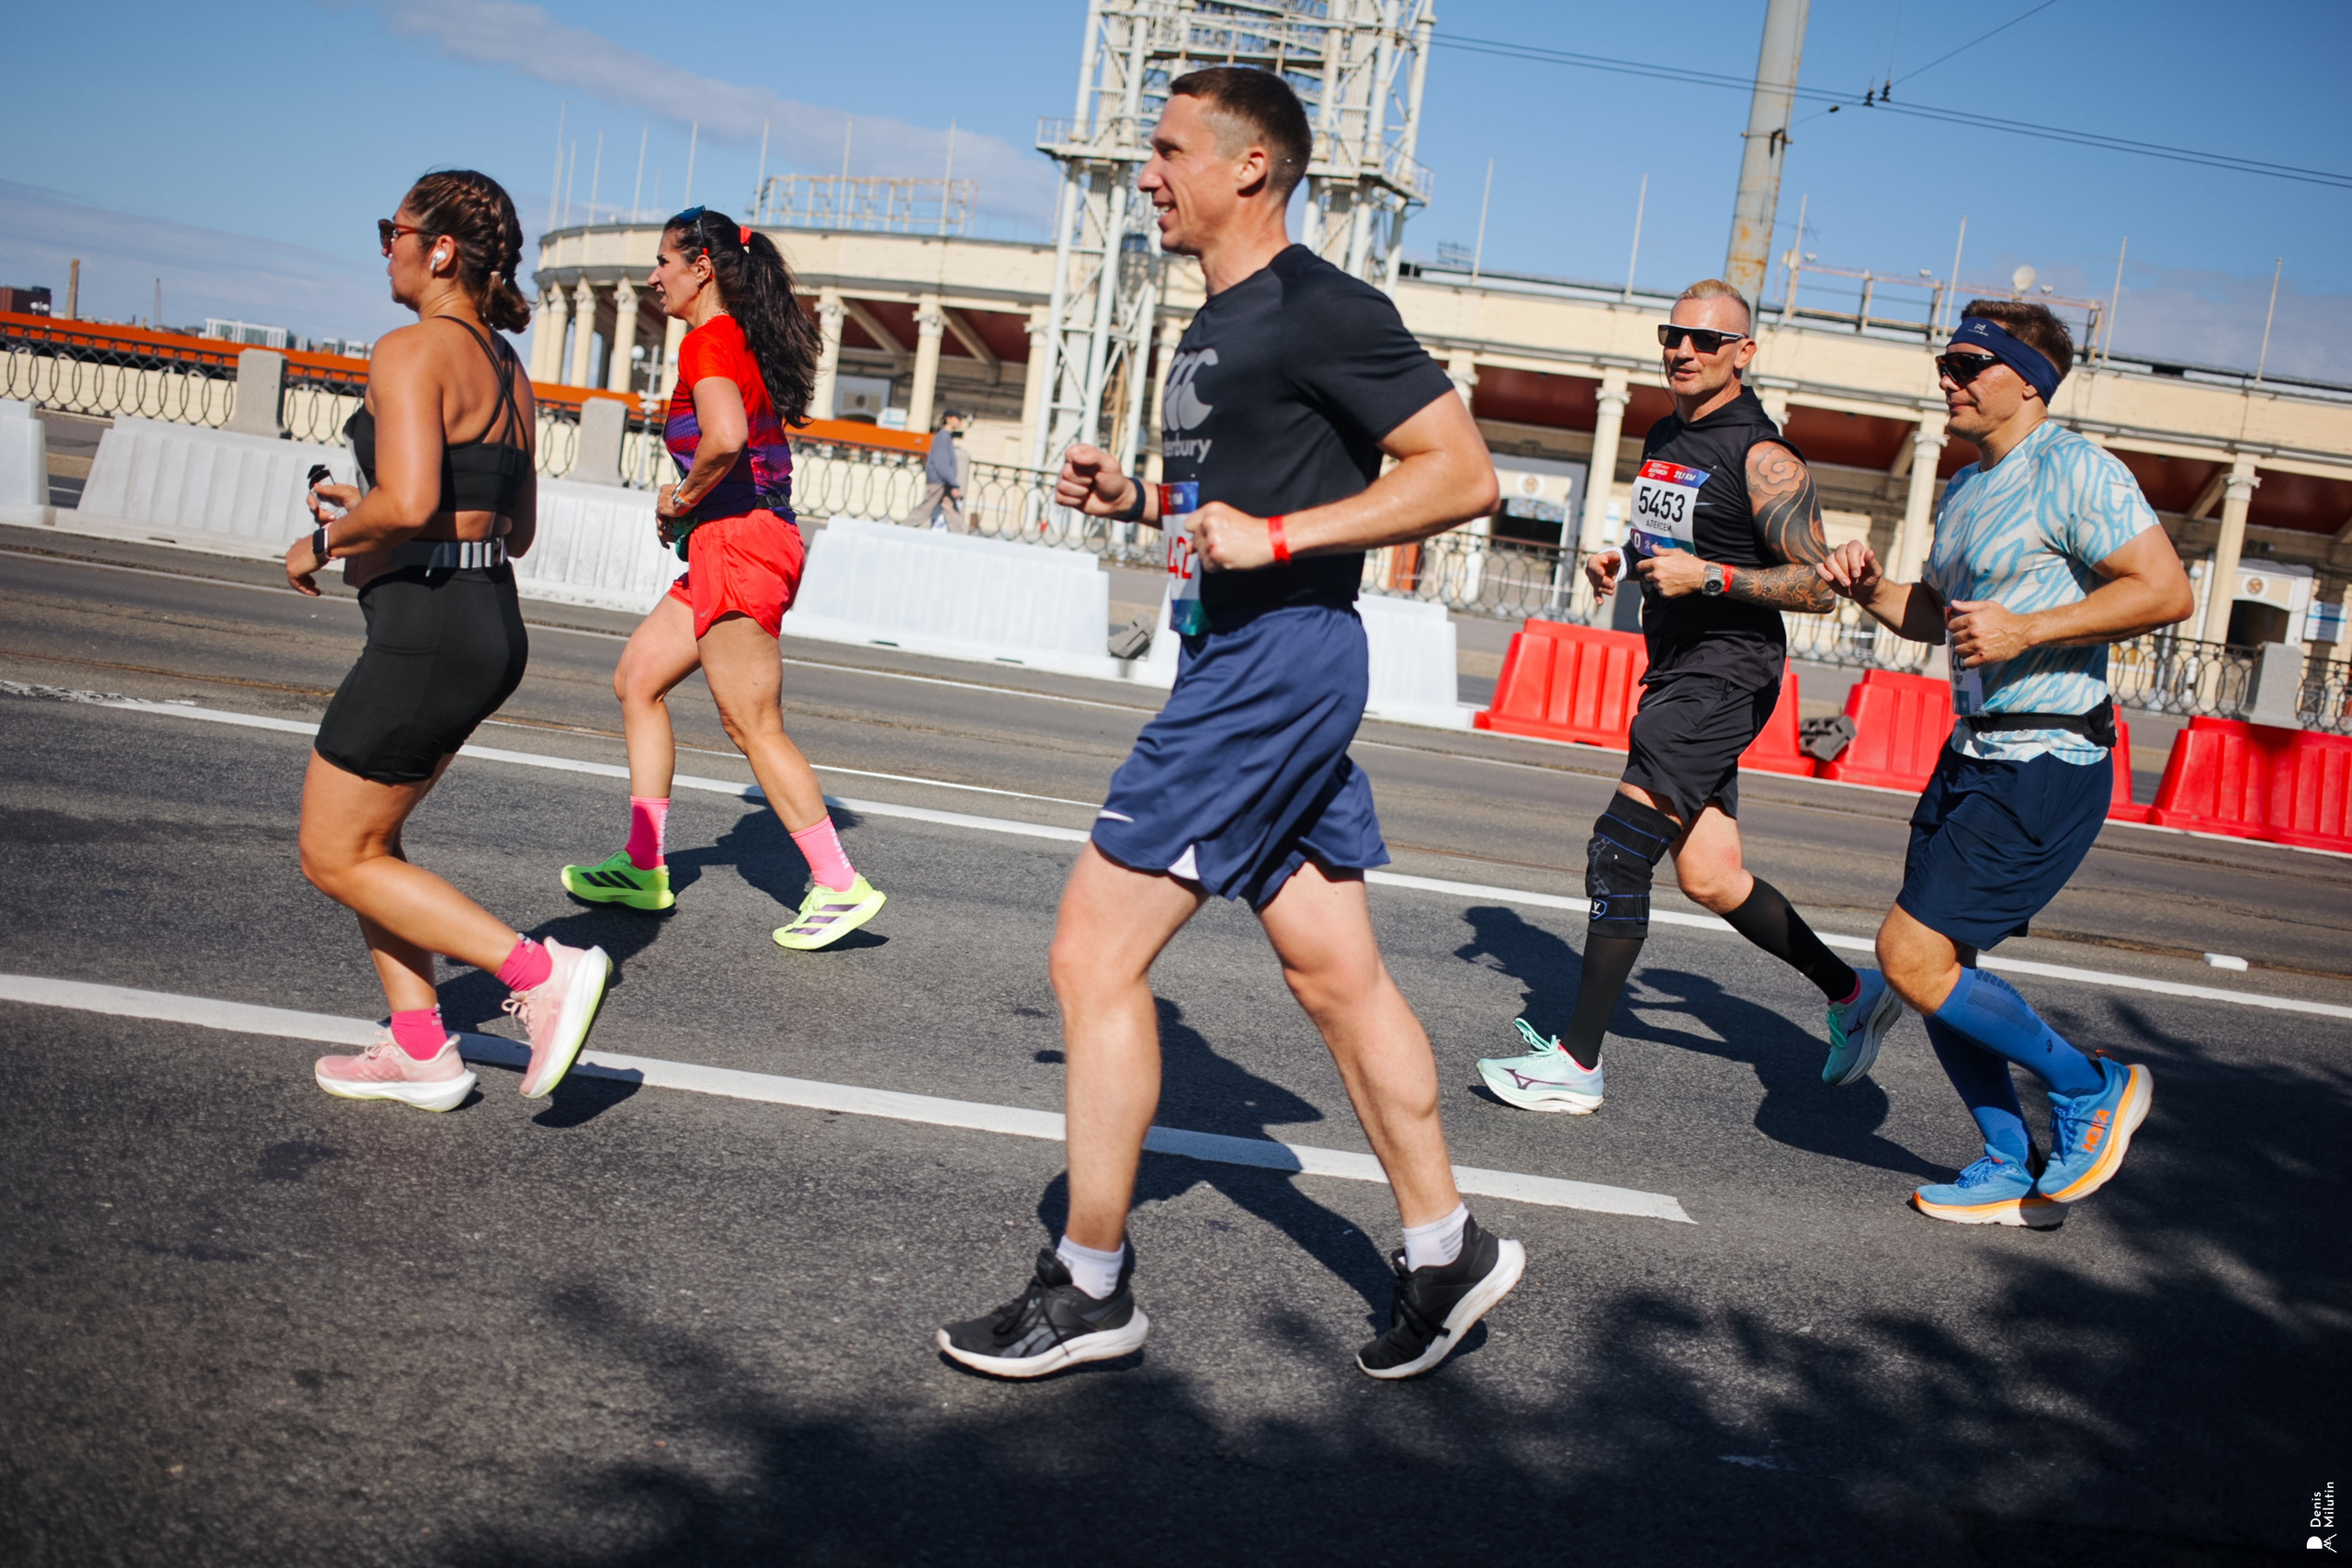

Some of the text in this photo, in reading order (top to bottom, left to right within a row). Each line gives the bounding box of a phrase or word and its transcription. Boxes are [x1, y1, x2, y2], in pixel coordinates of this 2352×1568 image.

[1638, 486, 1685, 523] 5453
[1645, 519, 1672, 533] АЛЕКСЕЙ
[2082, 1109, 2111, 1154] HOKA
